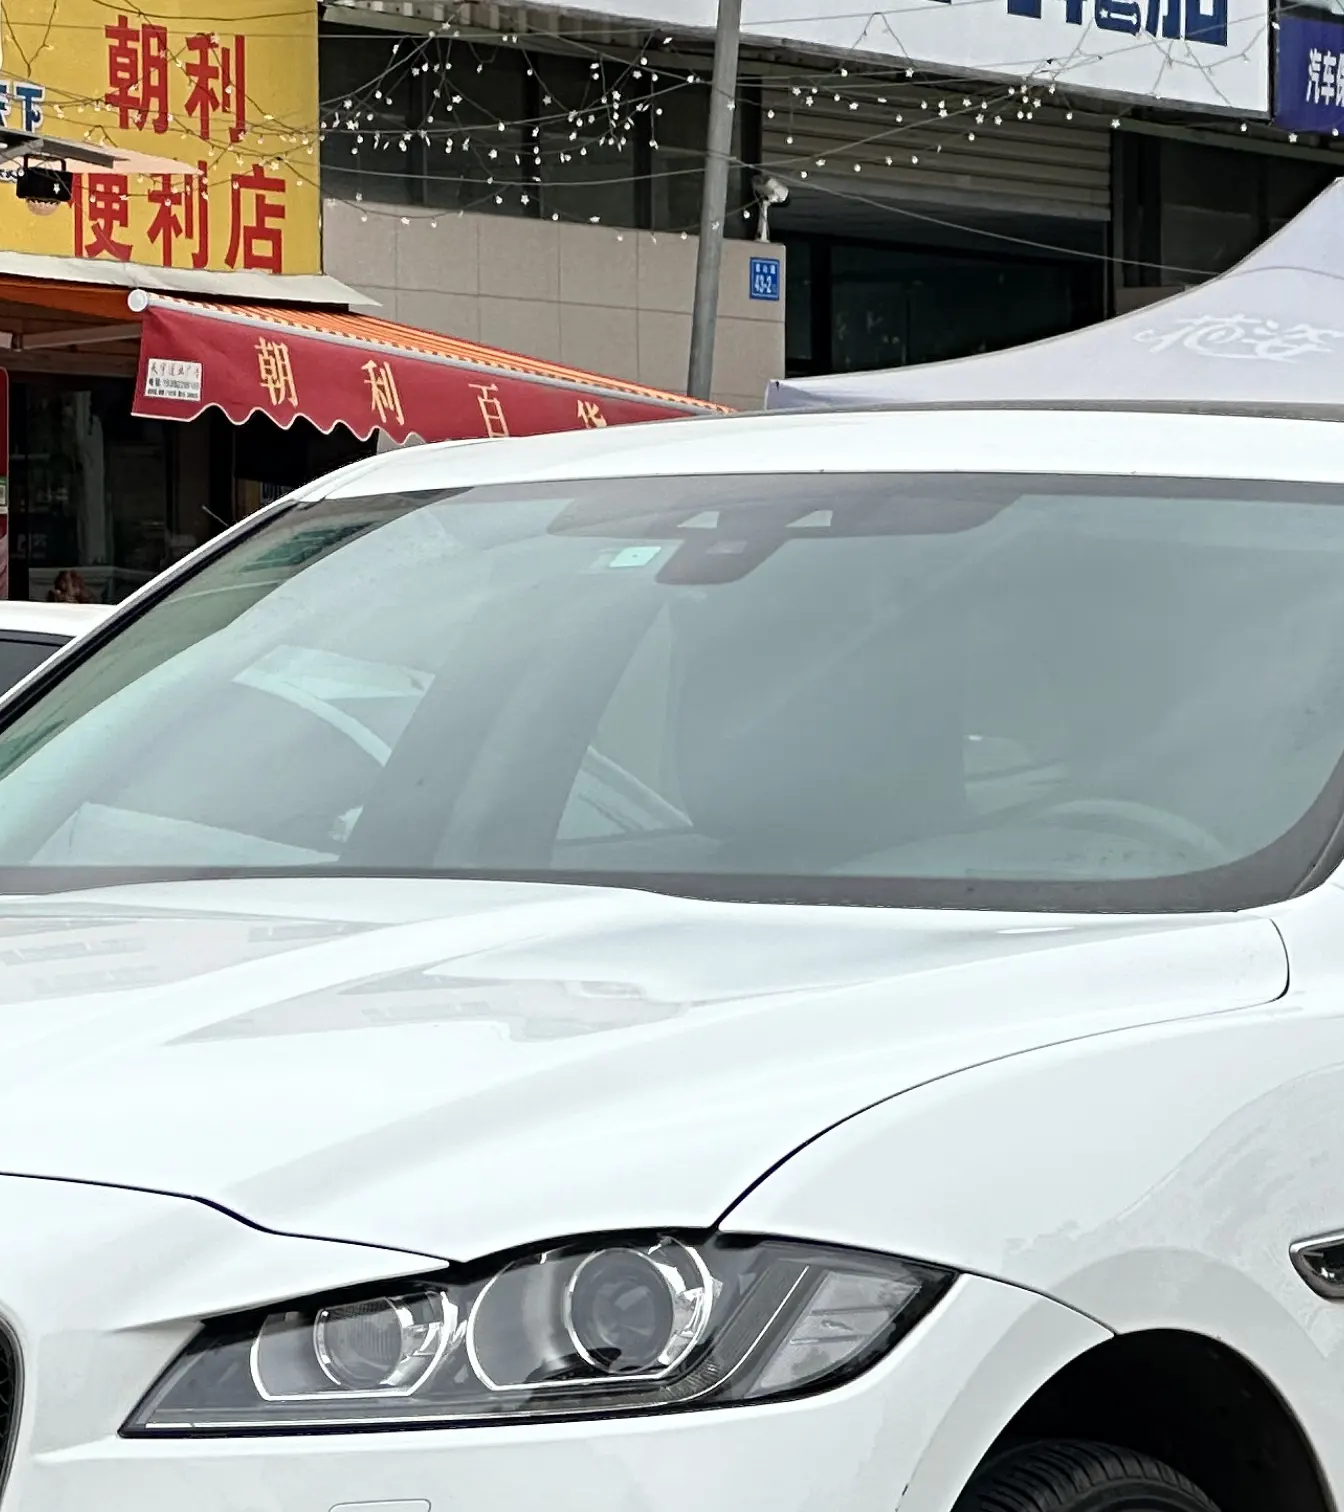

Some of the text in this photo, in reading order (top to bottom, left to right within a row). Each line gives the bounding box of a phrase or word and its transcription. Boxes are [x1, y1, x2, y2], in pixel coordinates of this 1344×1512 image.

[104, 16, 247, 143] 朝利
[70, 160, 287, 274] 便利店
